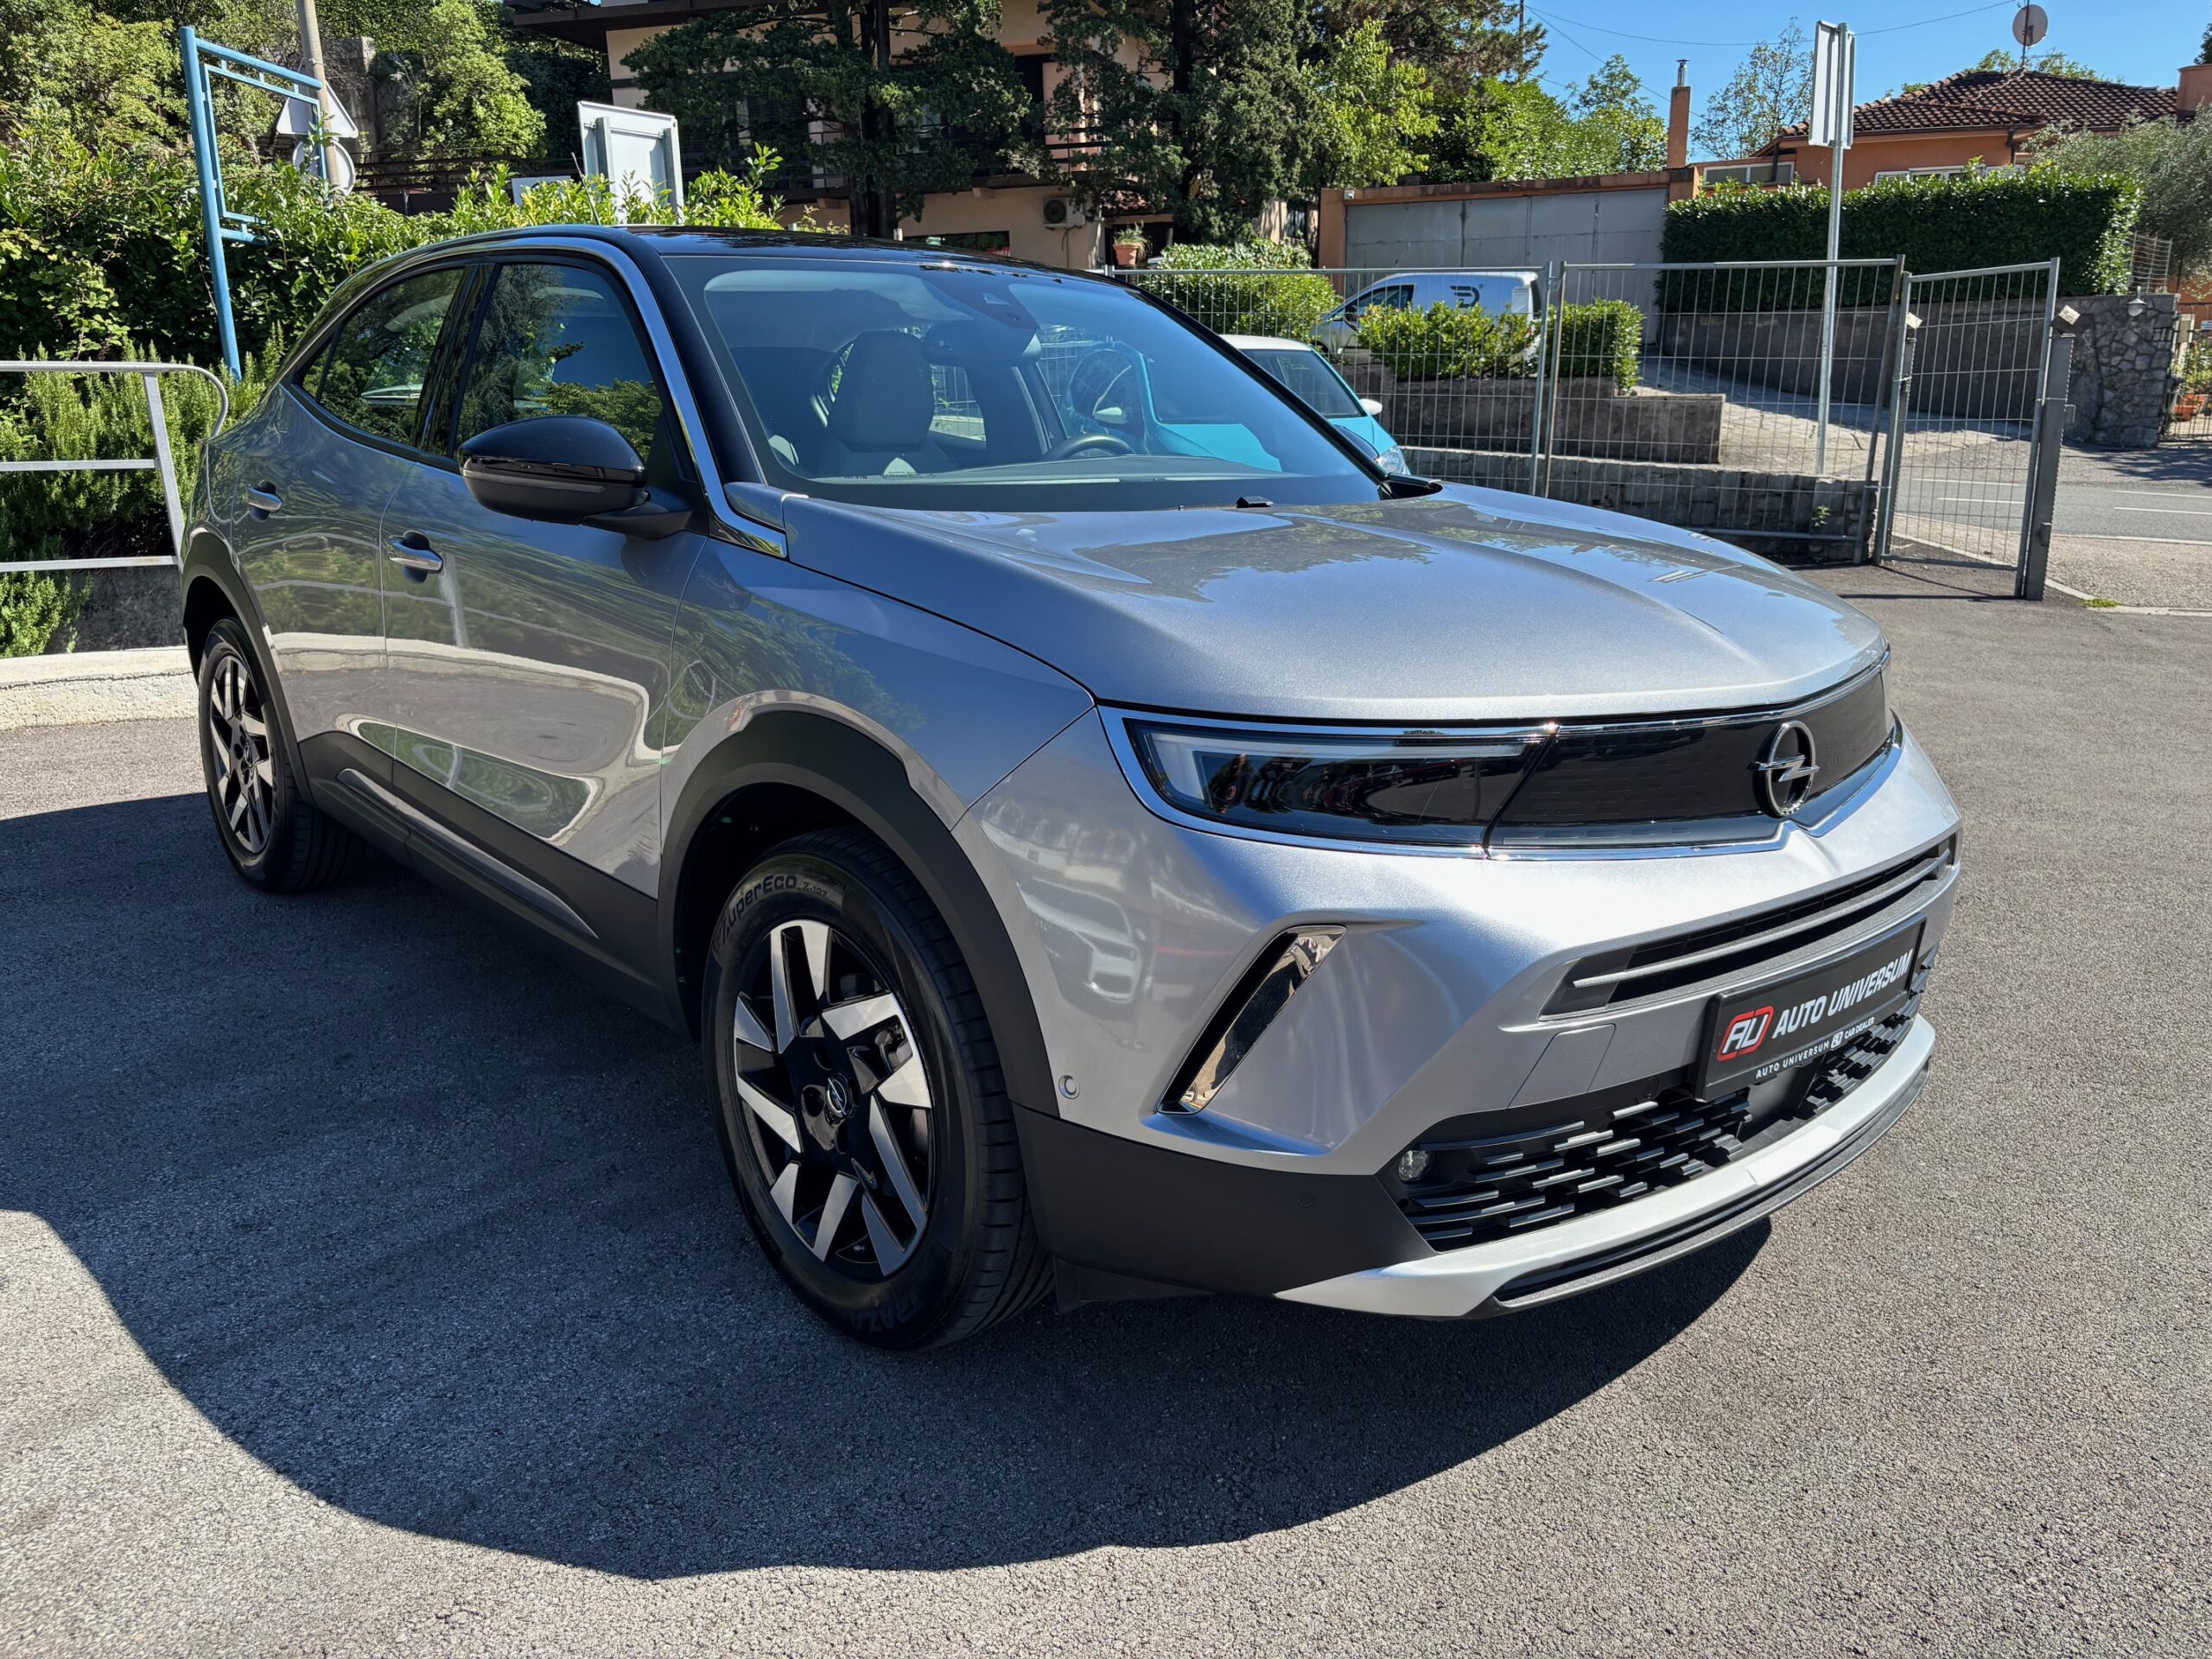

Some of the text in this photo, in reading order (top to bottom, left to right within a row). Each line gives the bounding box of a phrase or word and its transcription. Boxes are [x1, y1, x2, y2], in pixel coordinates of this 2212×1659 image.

[1772, 995, 1827, 1039] AUTO
[1827, 949, 1913, 1016] UNIVERSUM
[1756, 1063, 1780, 1079] AUTO
[1783, 1040, 1830, 1068] UNIVERSUM
[1844, 1027, 1855, 1039] CAR
[1855, 1016, 1875, 1033] DEALER
